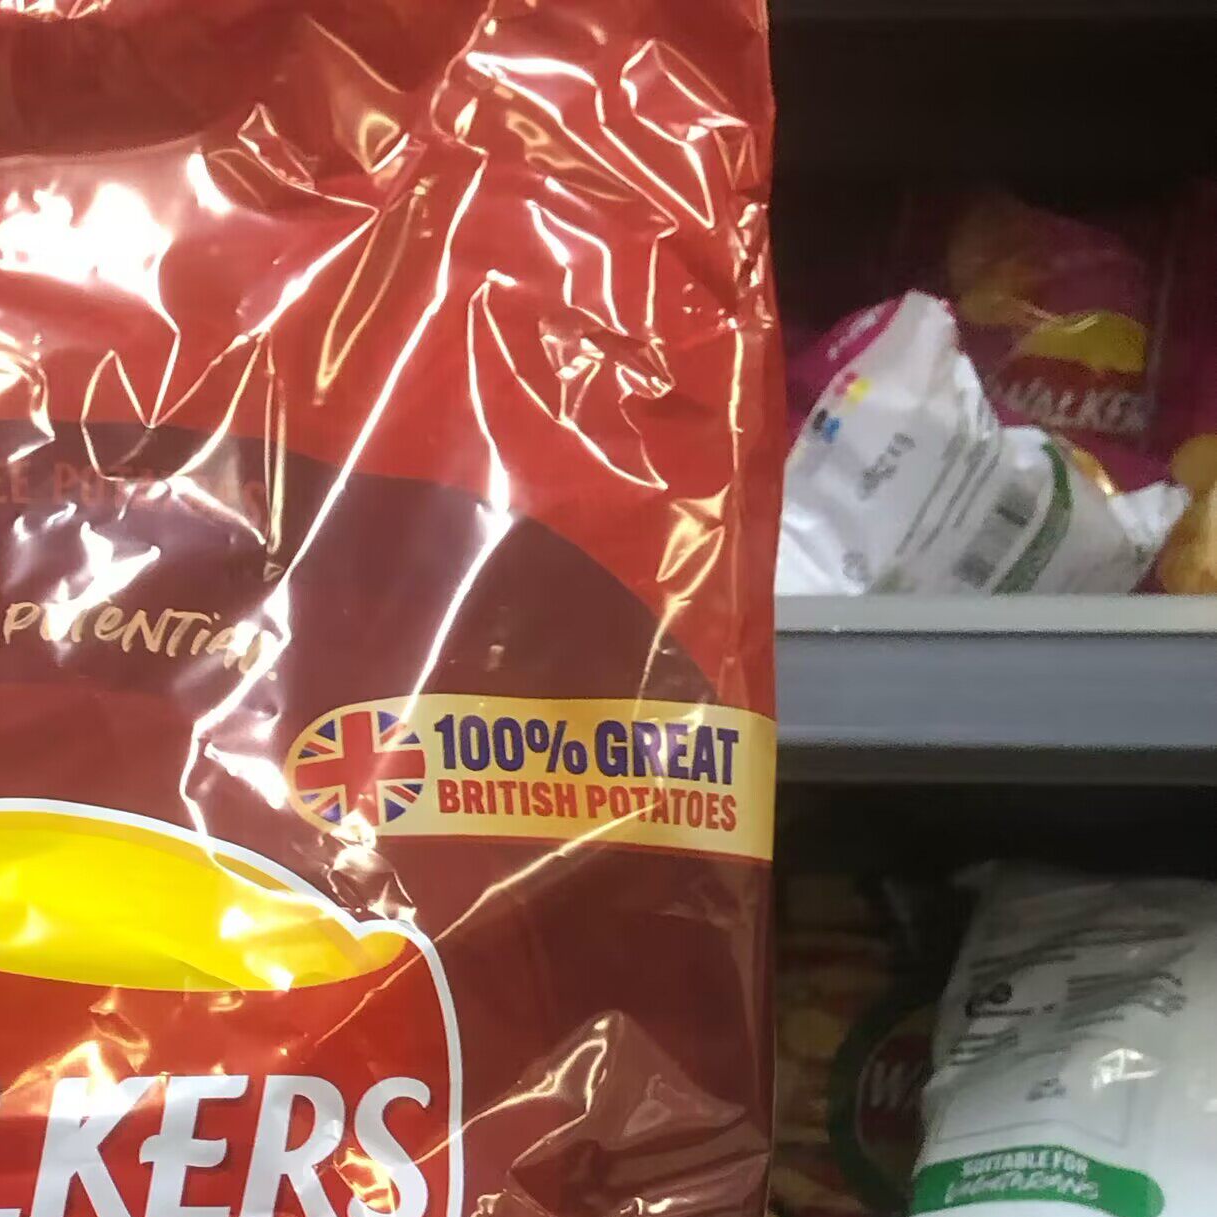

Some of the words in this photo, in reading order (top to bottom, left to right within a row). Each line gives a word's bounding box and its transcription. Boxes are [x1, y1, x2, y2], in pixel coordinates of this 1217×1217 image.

[434, 714, 588, 775] 100%
[594, 720, 740, 785] GREAT
[437, 779, 579, 818] BRITISH
[586, 785, 737, 832] POTATOES
